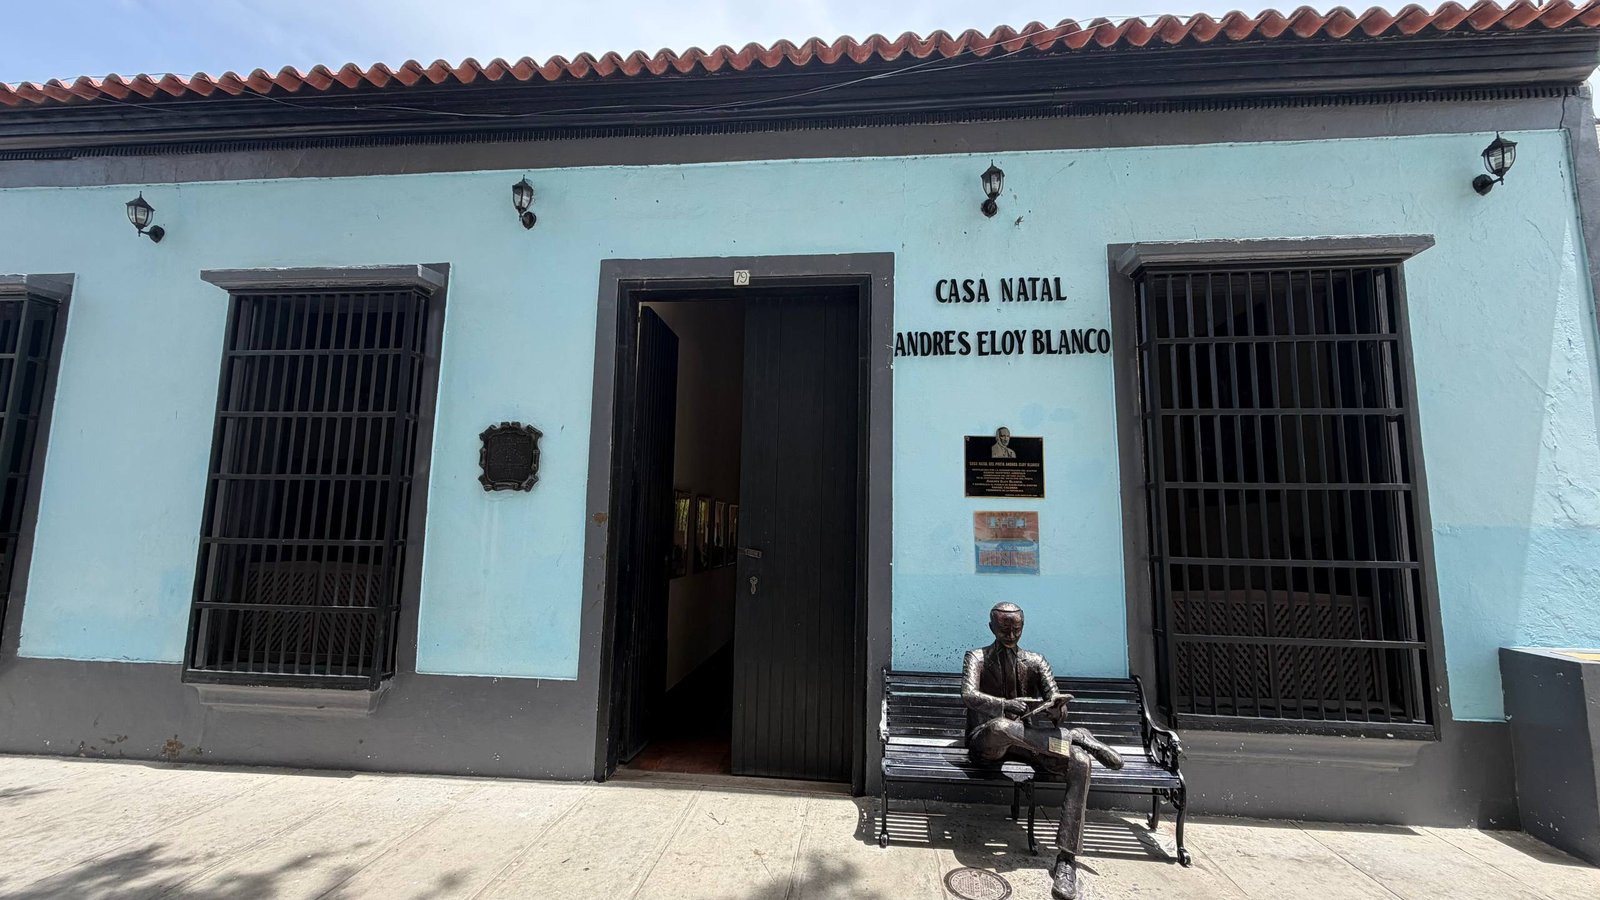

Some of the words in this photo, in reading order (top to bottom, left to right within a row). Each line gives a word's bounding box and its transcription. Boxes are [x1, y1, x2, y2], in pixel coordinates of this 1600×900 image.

[736, 271, 748, 284] 79
[935, 278, 990, 303] CASA
[1000, 277, 1068, 302] NATAL
[894, 331, 972, 357] ANDRES
[977, 330, 1027, 356] ELOY
[1032, 328, 1111, 355] BLANCO
